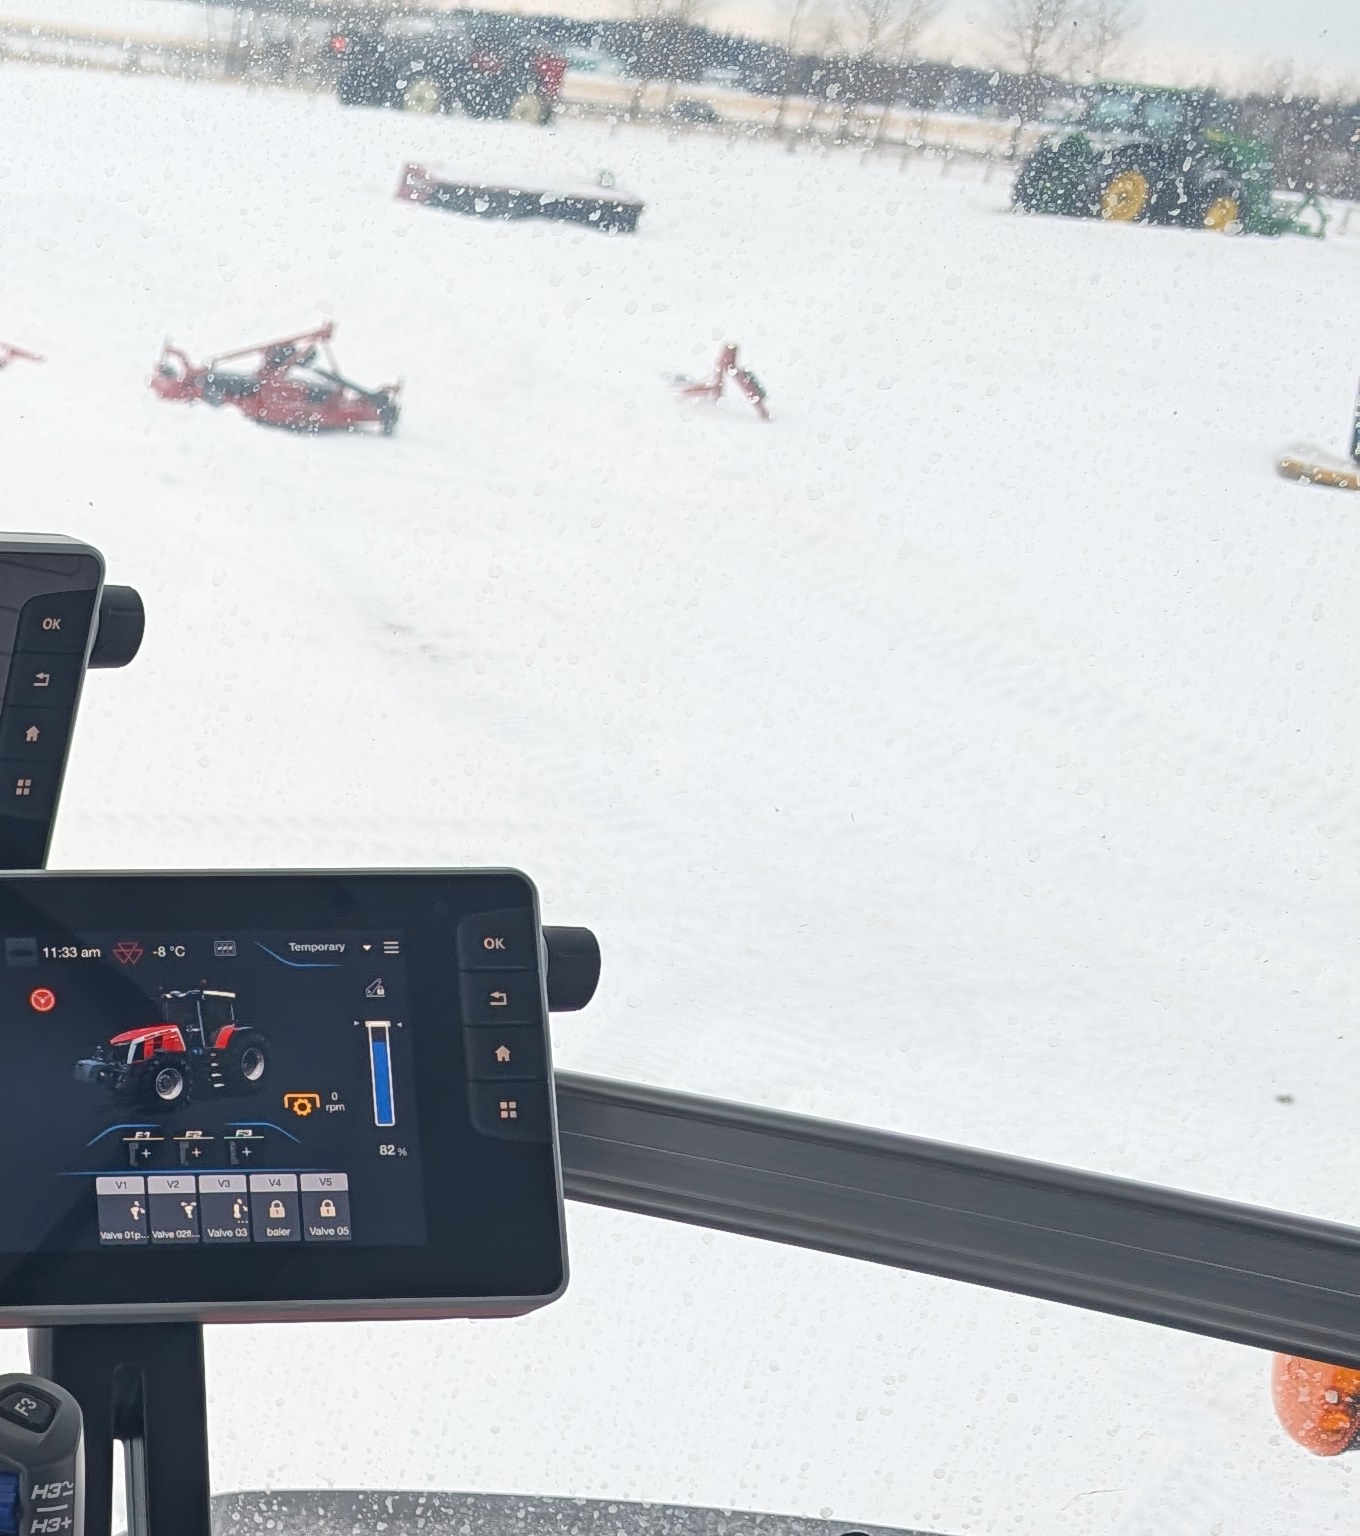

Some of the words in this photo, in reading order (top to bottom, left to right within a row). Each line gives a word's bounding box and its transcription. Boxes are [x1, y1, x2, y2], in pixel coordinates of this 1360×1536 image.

[42, 617, 62, 631] OK
[288, 942, 346, 953] Temporary
[483, 938, 506, 950] OK
[43, 946, 78, 959] 11:33
[80, 948, 101, 958] am
[152, 945, 167, 958] -8
[169, 945, 186, 957] °C
[325, 1103, 346, 1113] rpm
[379, 1144, 396, 1156] 82
[397, 1147, 408, 1157] %
[115, 1181, 128, 1190] V1
[166, 1180, 180, 1189] V2
[218, 1179, 231, 1188] V3
[268, 1178, 282, 1187] V4
[319, 1177, 333, 1187] V5
[100, 1231, 123, 1240] Valve
[152, 1230, 175, 1239] Valve
[207, 1228, 233, 1238] Valve
[235, 1228, 248, 1237] 03
[309, 1226, 335, 1236] Valve
[336, 1226, 349, 1235] 05
[13, 1397, 38, 1417] F3
